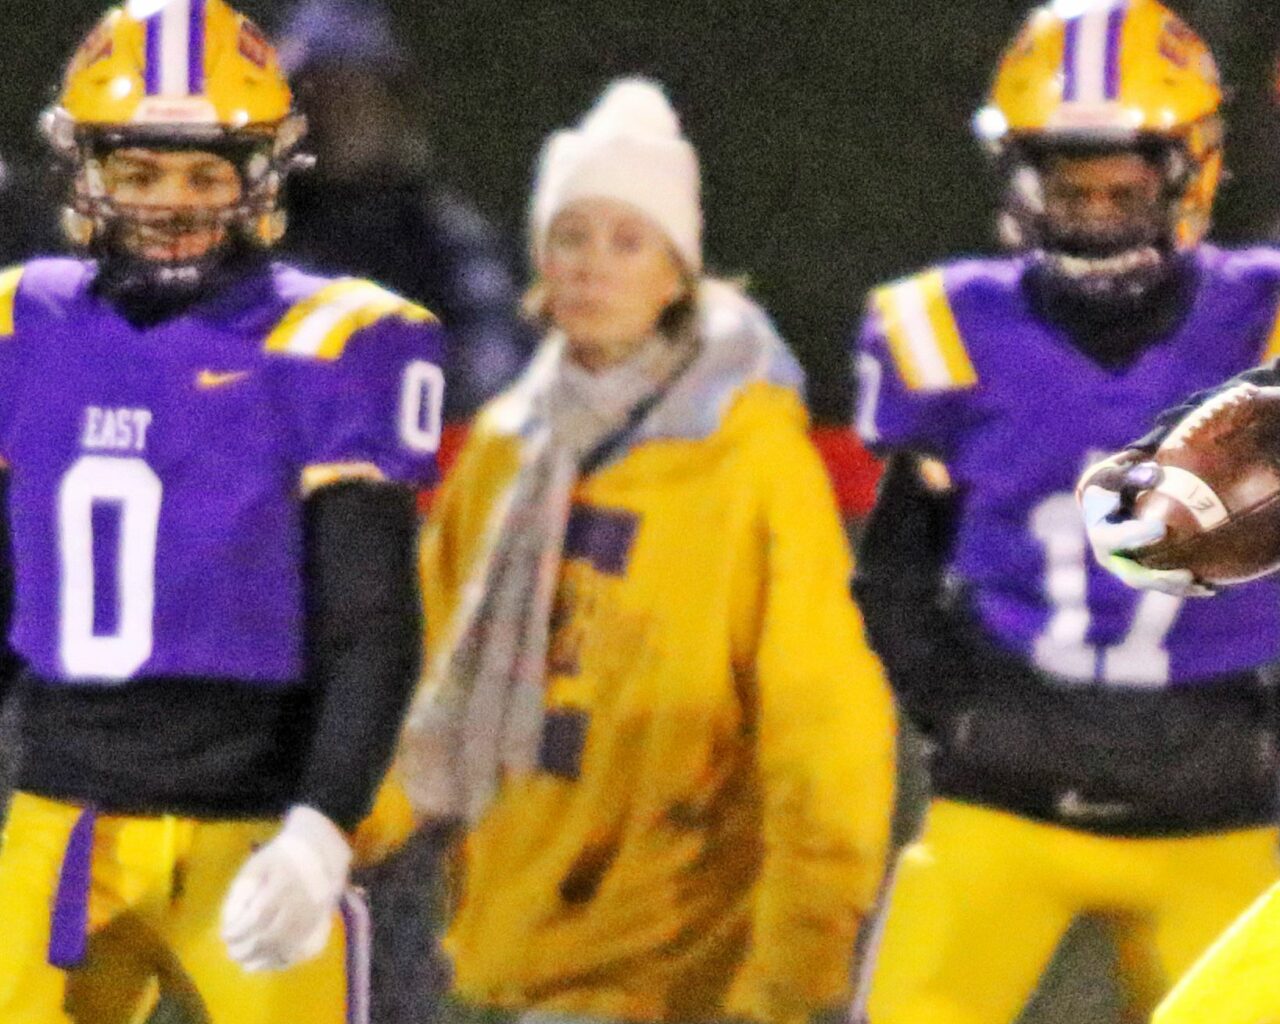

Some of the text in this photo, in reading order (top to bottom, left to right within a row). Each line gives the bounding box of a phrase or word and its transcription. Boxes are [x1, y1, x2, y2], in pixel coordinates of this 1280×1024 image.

[84, 405, 152, 450] EAST
[401, 360, 445, 452] 0
[60, 455, 162, 678] 0
